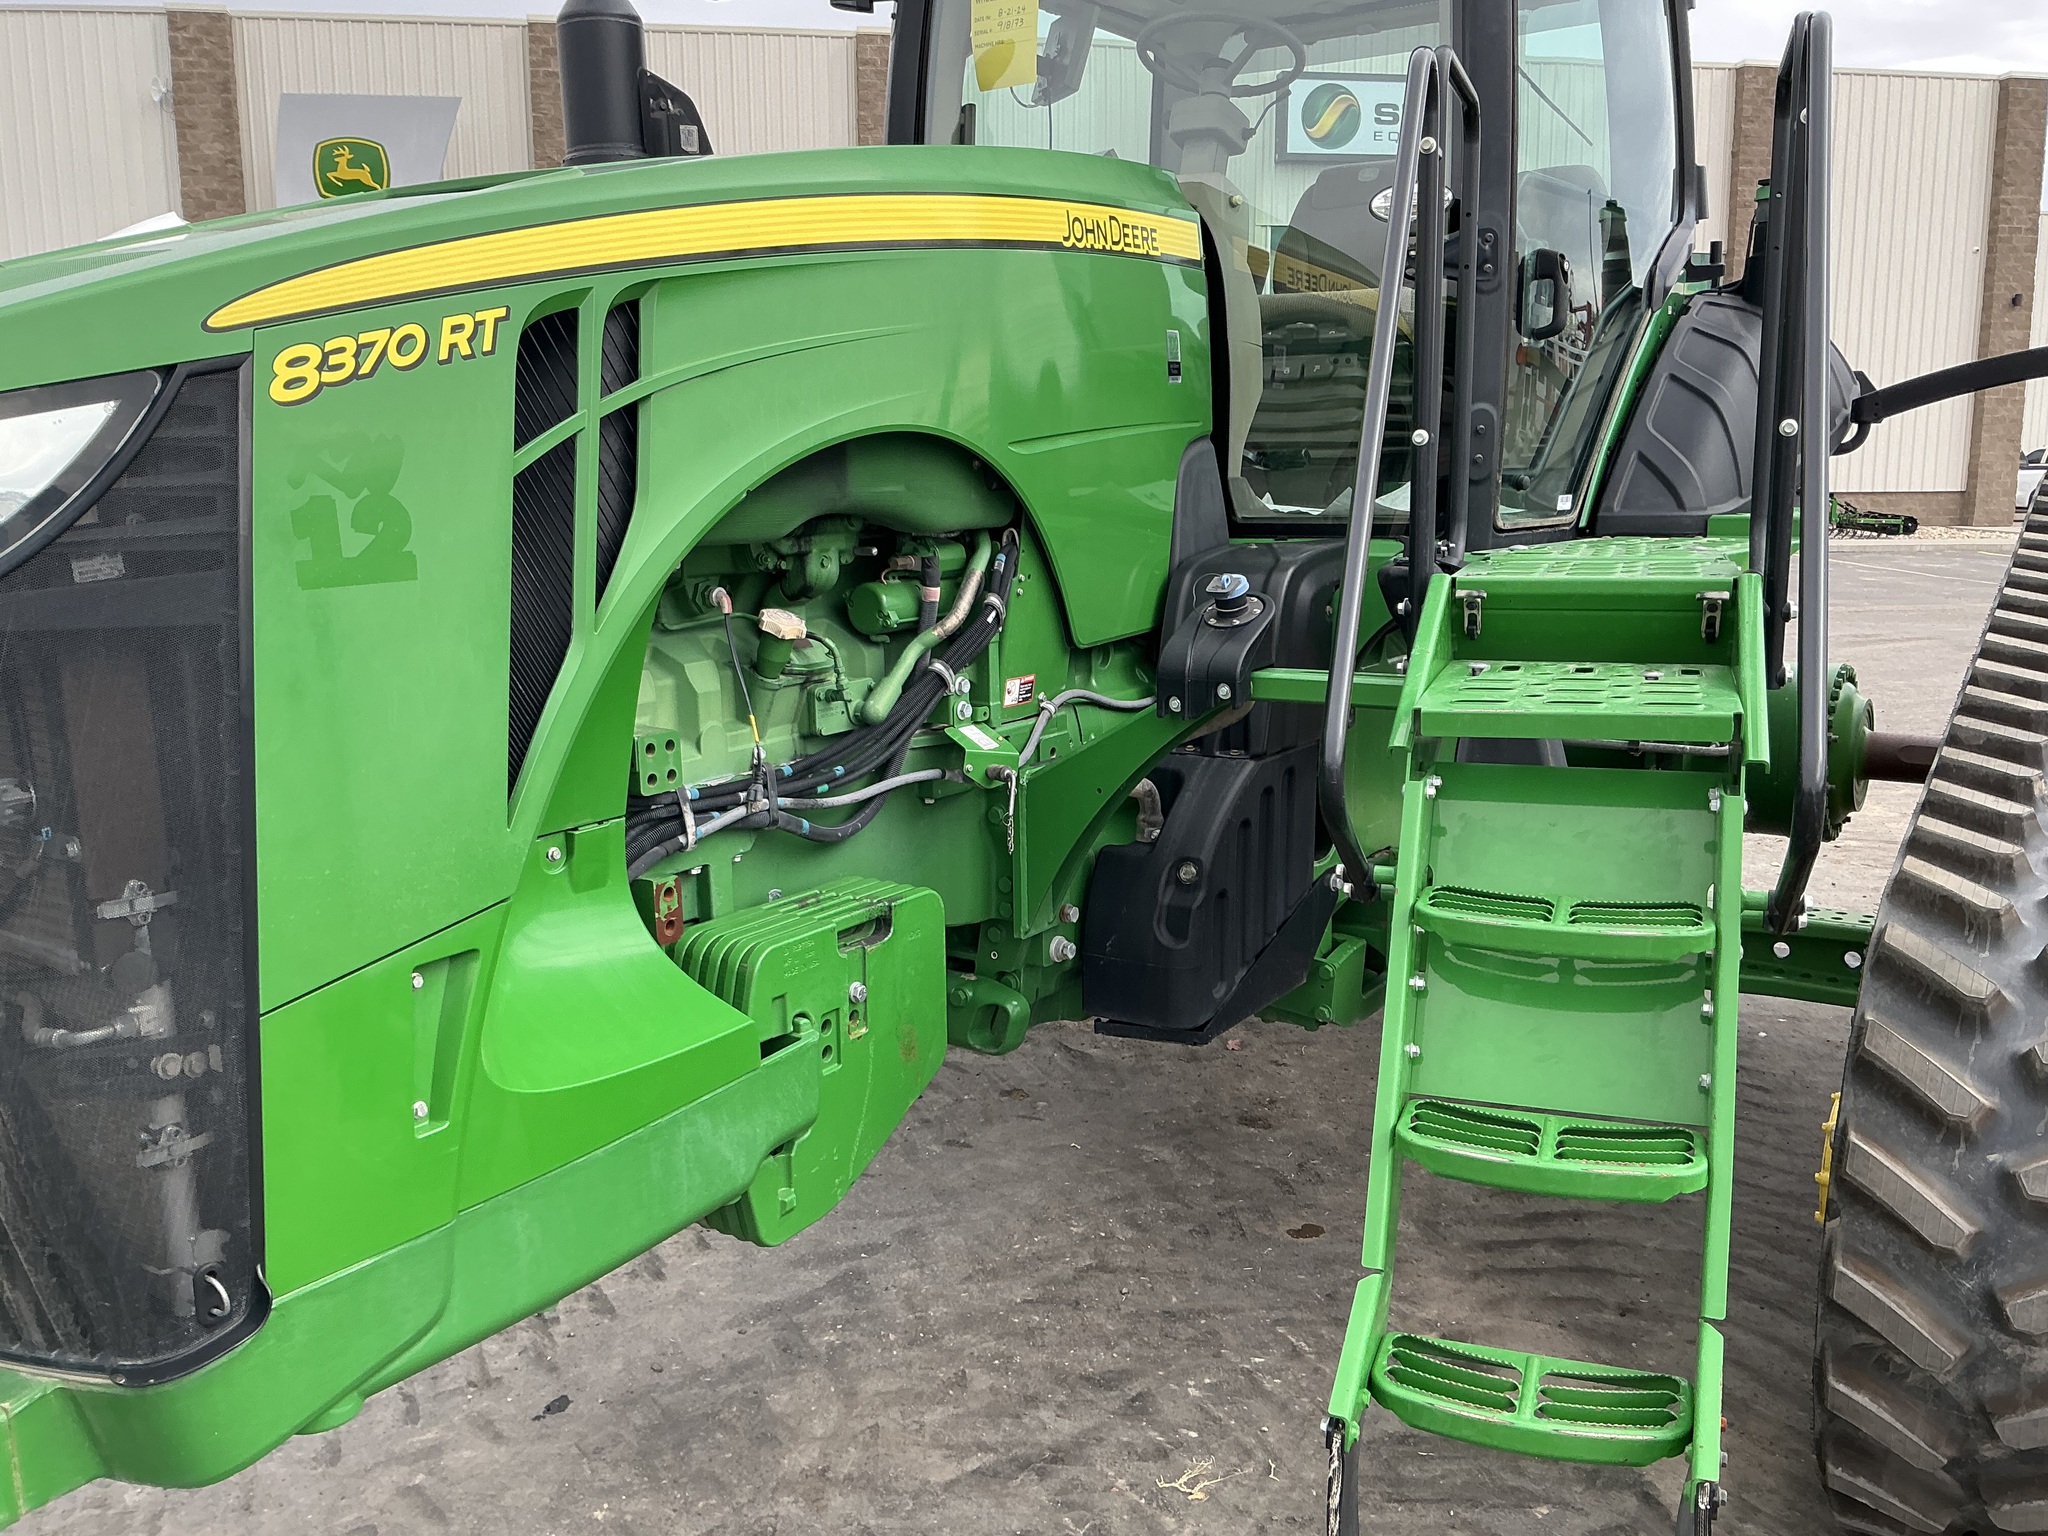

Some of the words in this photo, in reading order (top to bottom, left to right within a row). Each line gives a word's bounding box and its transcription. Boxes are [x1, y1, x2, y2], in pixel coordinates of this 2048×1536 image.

[997, 5, 1026, 17] 8-21-24
[1374, 103, 1404, 126] S
[268, 322, 431, 408] 8370
[437, 305, 511, 366] RT
[290, 494, 419, 591] 12
